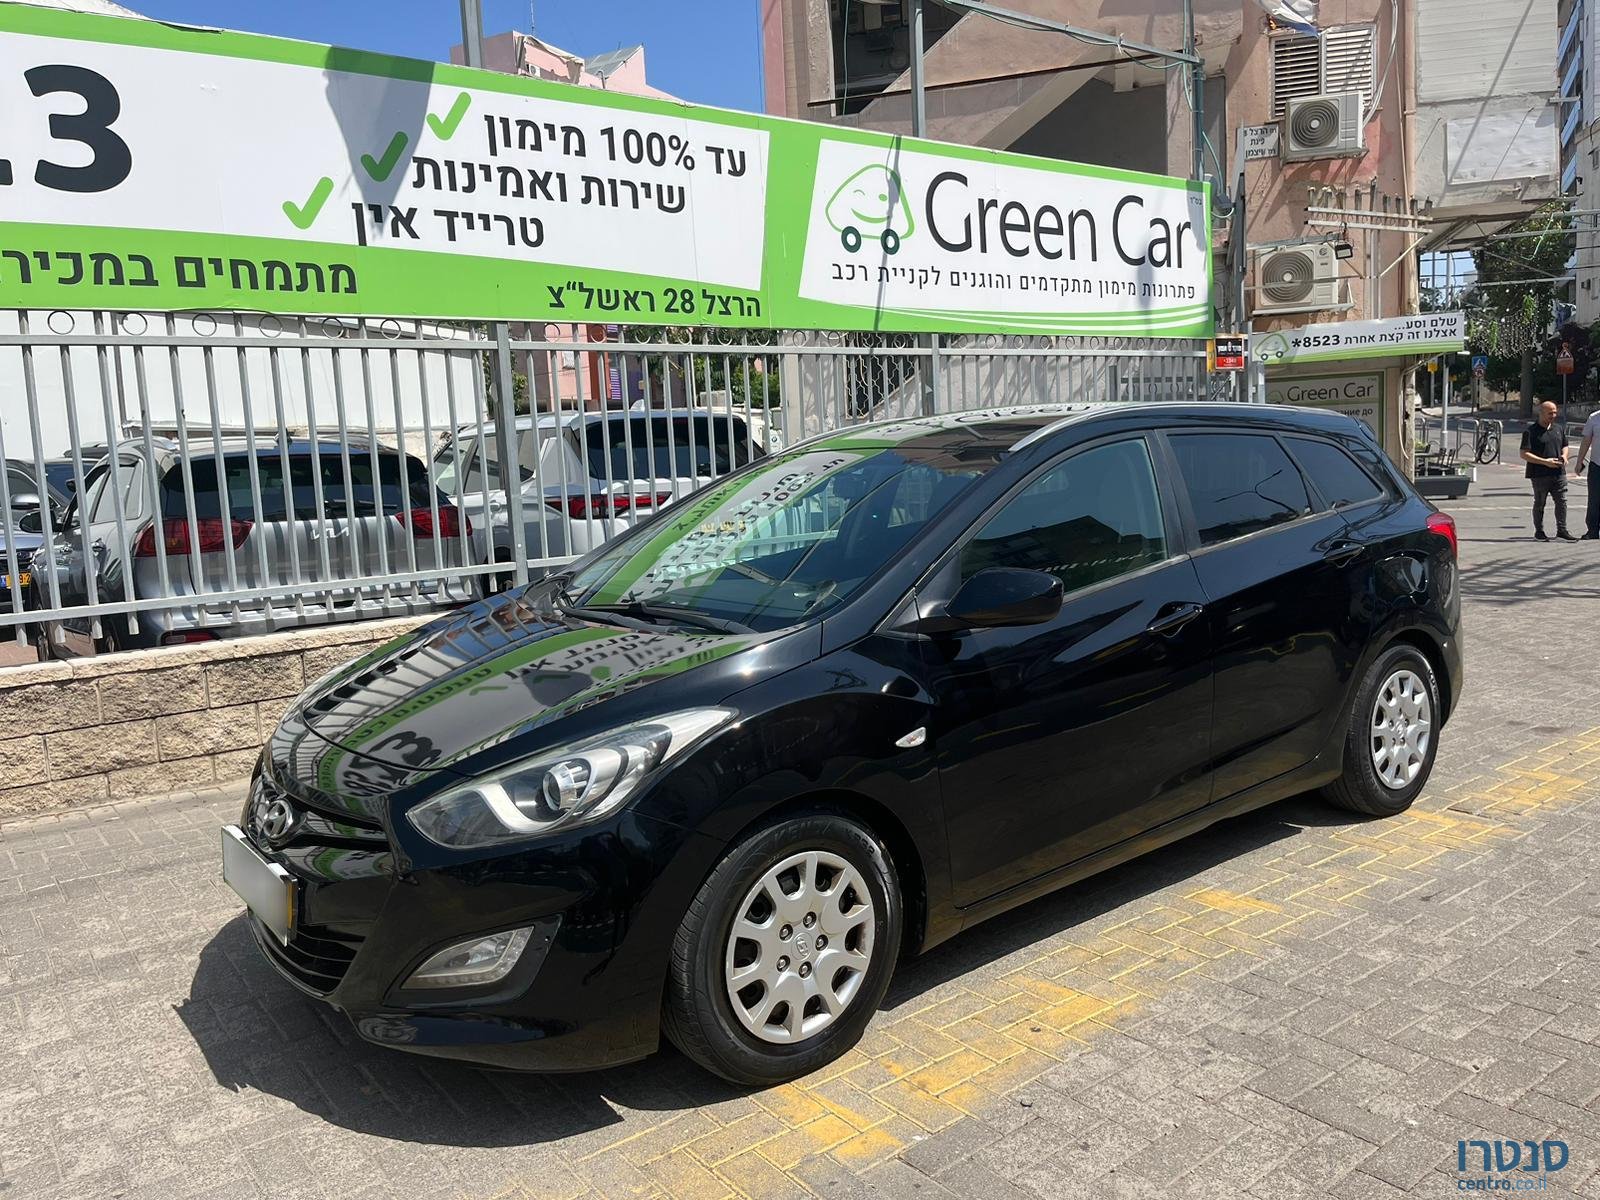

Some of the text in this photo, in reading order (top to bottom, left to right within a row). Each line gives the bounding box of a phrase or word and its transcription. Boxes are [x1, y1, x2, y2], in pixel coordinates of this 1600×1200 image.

[0, 64, 132, 193] 3
[1250, 137, 1265, 146] פינת
[484, 114, 746, 177] עד 100% מימון
[412, 156, 686, 214] שירות ואמינות
[351, 202, 545, 248] טרייד אין
[925, 171, 1192, 269] Green Car
[0, 250, 358, 294] מתמחים במכיר
[832, 263, 1196, 299] פתרונות מימון מתקדמים והוגנים לקניית רכב
[663, 287, 695, 315] 28
[702, 288, 761, 318] הרצל
[1407, 331, 1421, 341] זה
[1423, 327, 1457, 340] אצלנו
[1430, 316, 1457, 328] שלם
[1344, 334, 1376, 345] אחרת
[1379, 332, 1404, 344] קצת
[1287, 381, 1374, 402] Green Car
